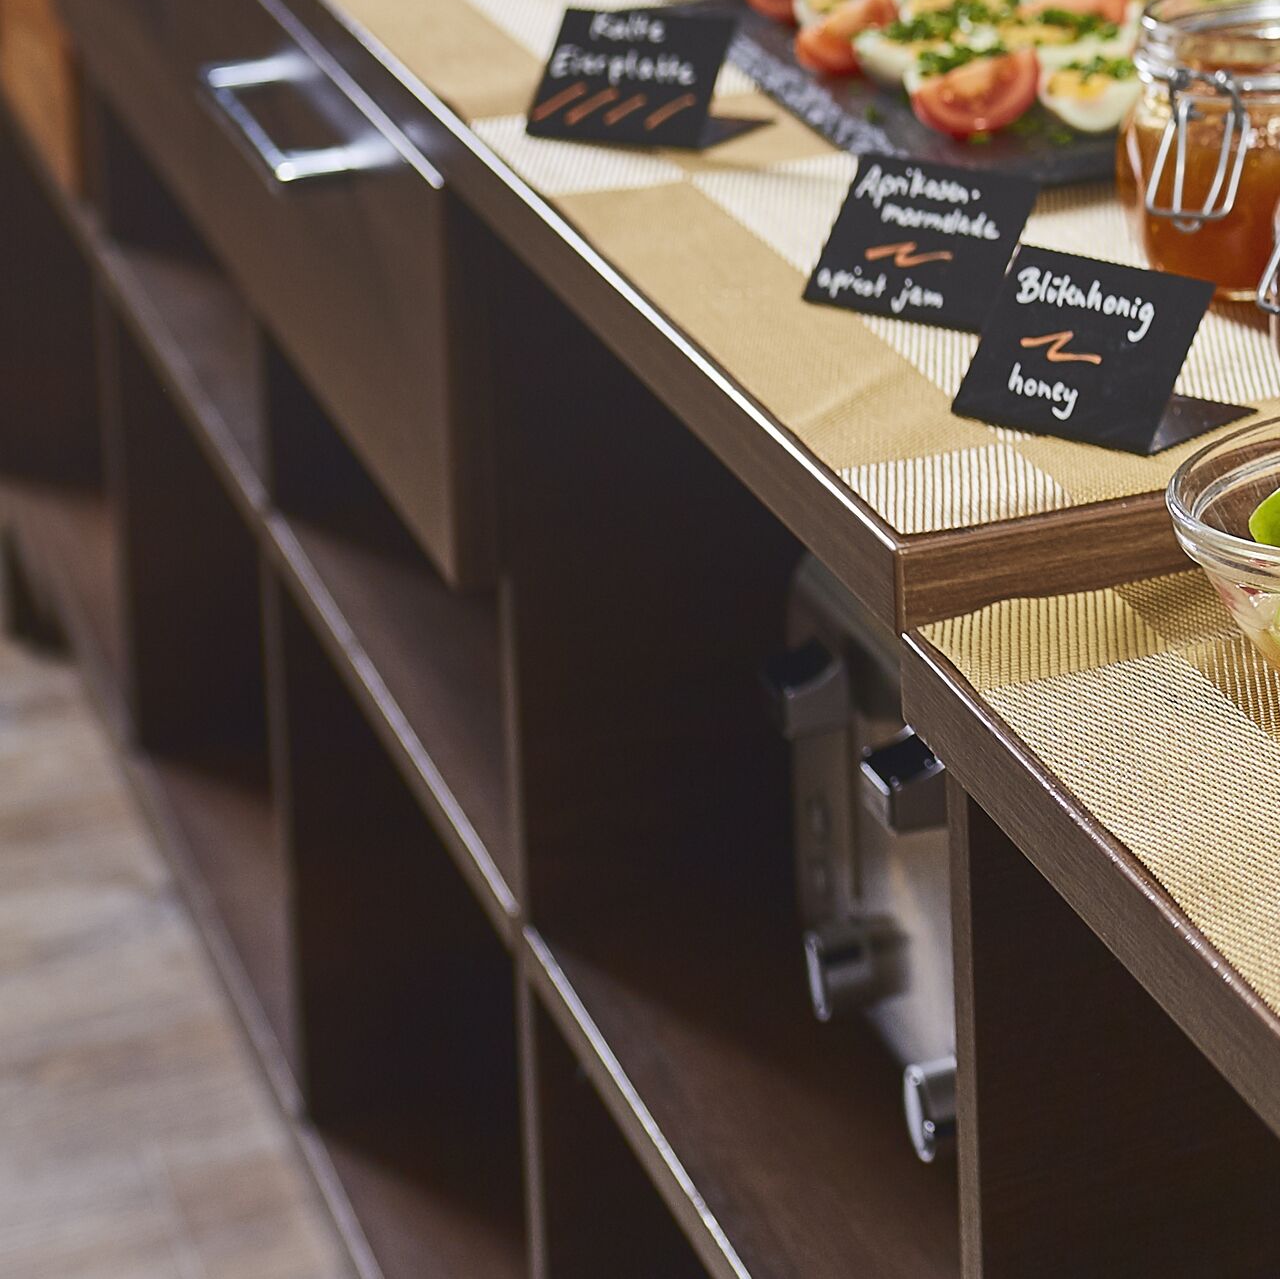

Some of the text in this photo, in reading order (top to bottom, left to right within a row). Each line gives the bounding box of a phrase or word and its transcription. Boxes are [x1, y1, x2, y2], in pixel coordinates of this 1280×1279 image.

[817, 265, 944, 313] apricot jam
[1008, 362, 1079, 421] honey
